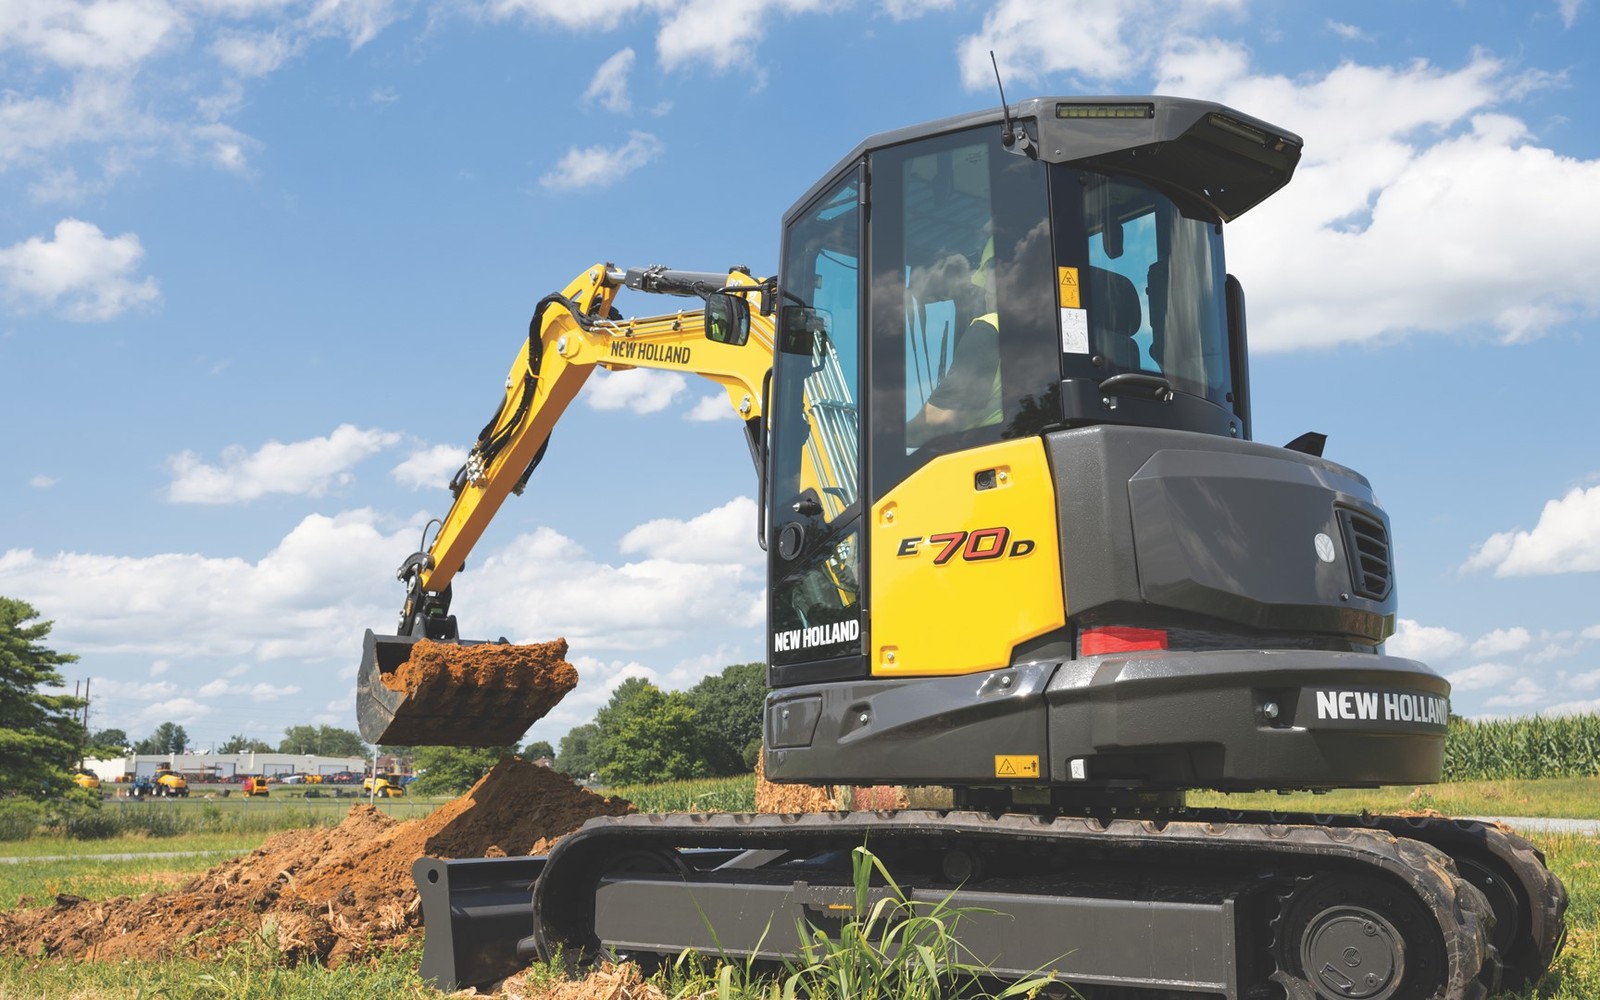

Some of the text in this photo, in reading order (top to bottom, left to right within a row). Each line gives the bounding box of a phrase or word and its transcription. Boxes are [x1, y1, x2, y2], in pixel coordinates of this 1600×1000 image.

[611, 341, 691, 364] NEW HOLLAND
[775, 619, 859, 652] NEW HOLLAND
[1316, 691, 1447, 725] NEW HOLLAND
